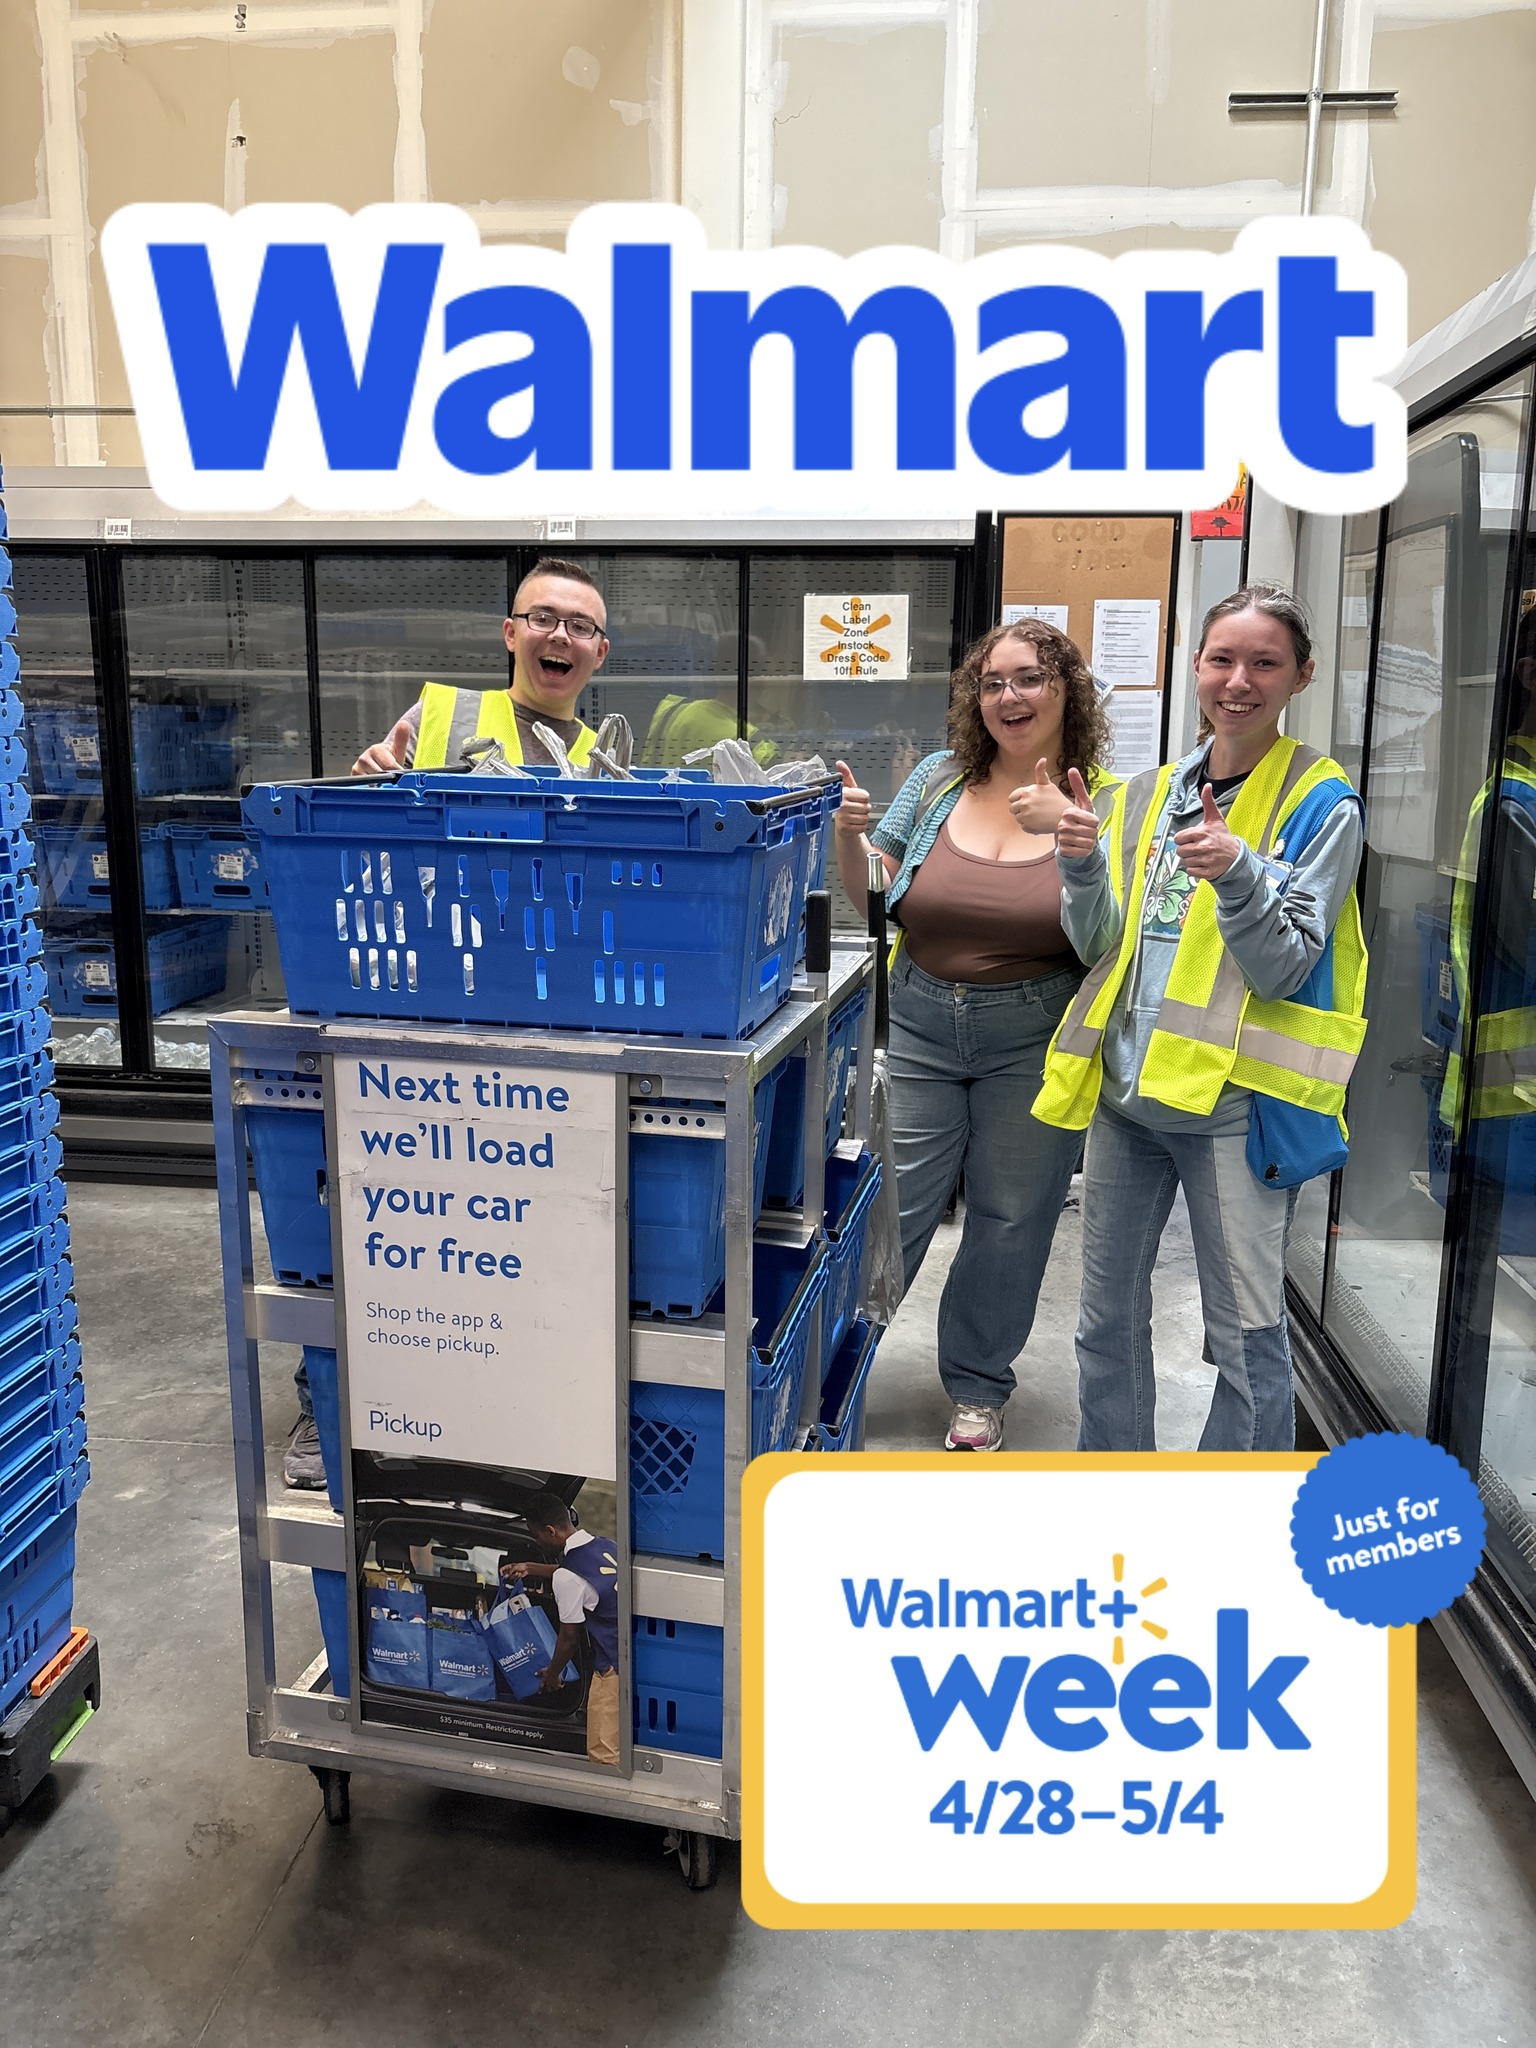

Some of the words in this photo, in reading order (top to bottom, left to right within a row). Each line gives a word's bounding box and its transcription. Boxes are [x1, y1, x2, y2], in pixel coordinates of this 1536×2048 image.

[842, 602, 871, 611] Clean
[843, 615, 871, 624] Label
[843, 628, 869, 637] Zone
[838, 641, 875, 650] Instock
[827, 654, 856, 663] Dress
[859, 654, 886, 663] Code
[834, 666, 852, 675] 10ft
[855, 666, 878, 675] Rule
[358, 1061, 461, 1104] Next
[472, 1071, 570, 1112] time
[360, 1122, 452, 1160] we’ll
[467, 1127, 554, 1168] load
[362, 1186, 455, 1222] your
[467, 1194, 531, 1222] car
[364, 1231, 427, 1270] for
[437, 1237, 522, 1279] free
[366, 1301, 411, 1325] Shop
[416, 1306, 446, 1324] the
[451, 1313, 483, 1332] app
[490, 1312, 503, 1330] &
[367, 1327, 431, 1348] choose
[437, 1334, 500, 1359] pickup.
[369, 1410, 442, 1442] Pickup
[372, 1647, 408, 1660] Walmart
[498, 1648, 527, 1667] Walmart
[439, 1659, 476, 1673] Walmart
[440, 1715, 453, 1724] $35
[453, 1719, 484, 1730] minimum.
[485, 1722, 524, 1736] Restrictions
[525, 1730, 545, 1740] apply.
